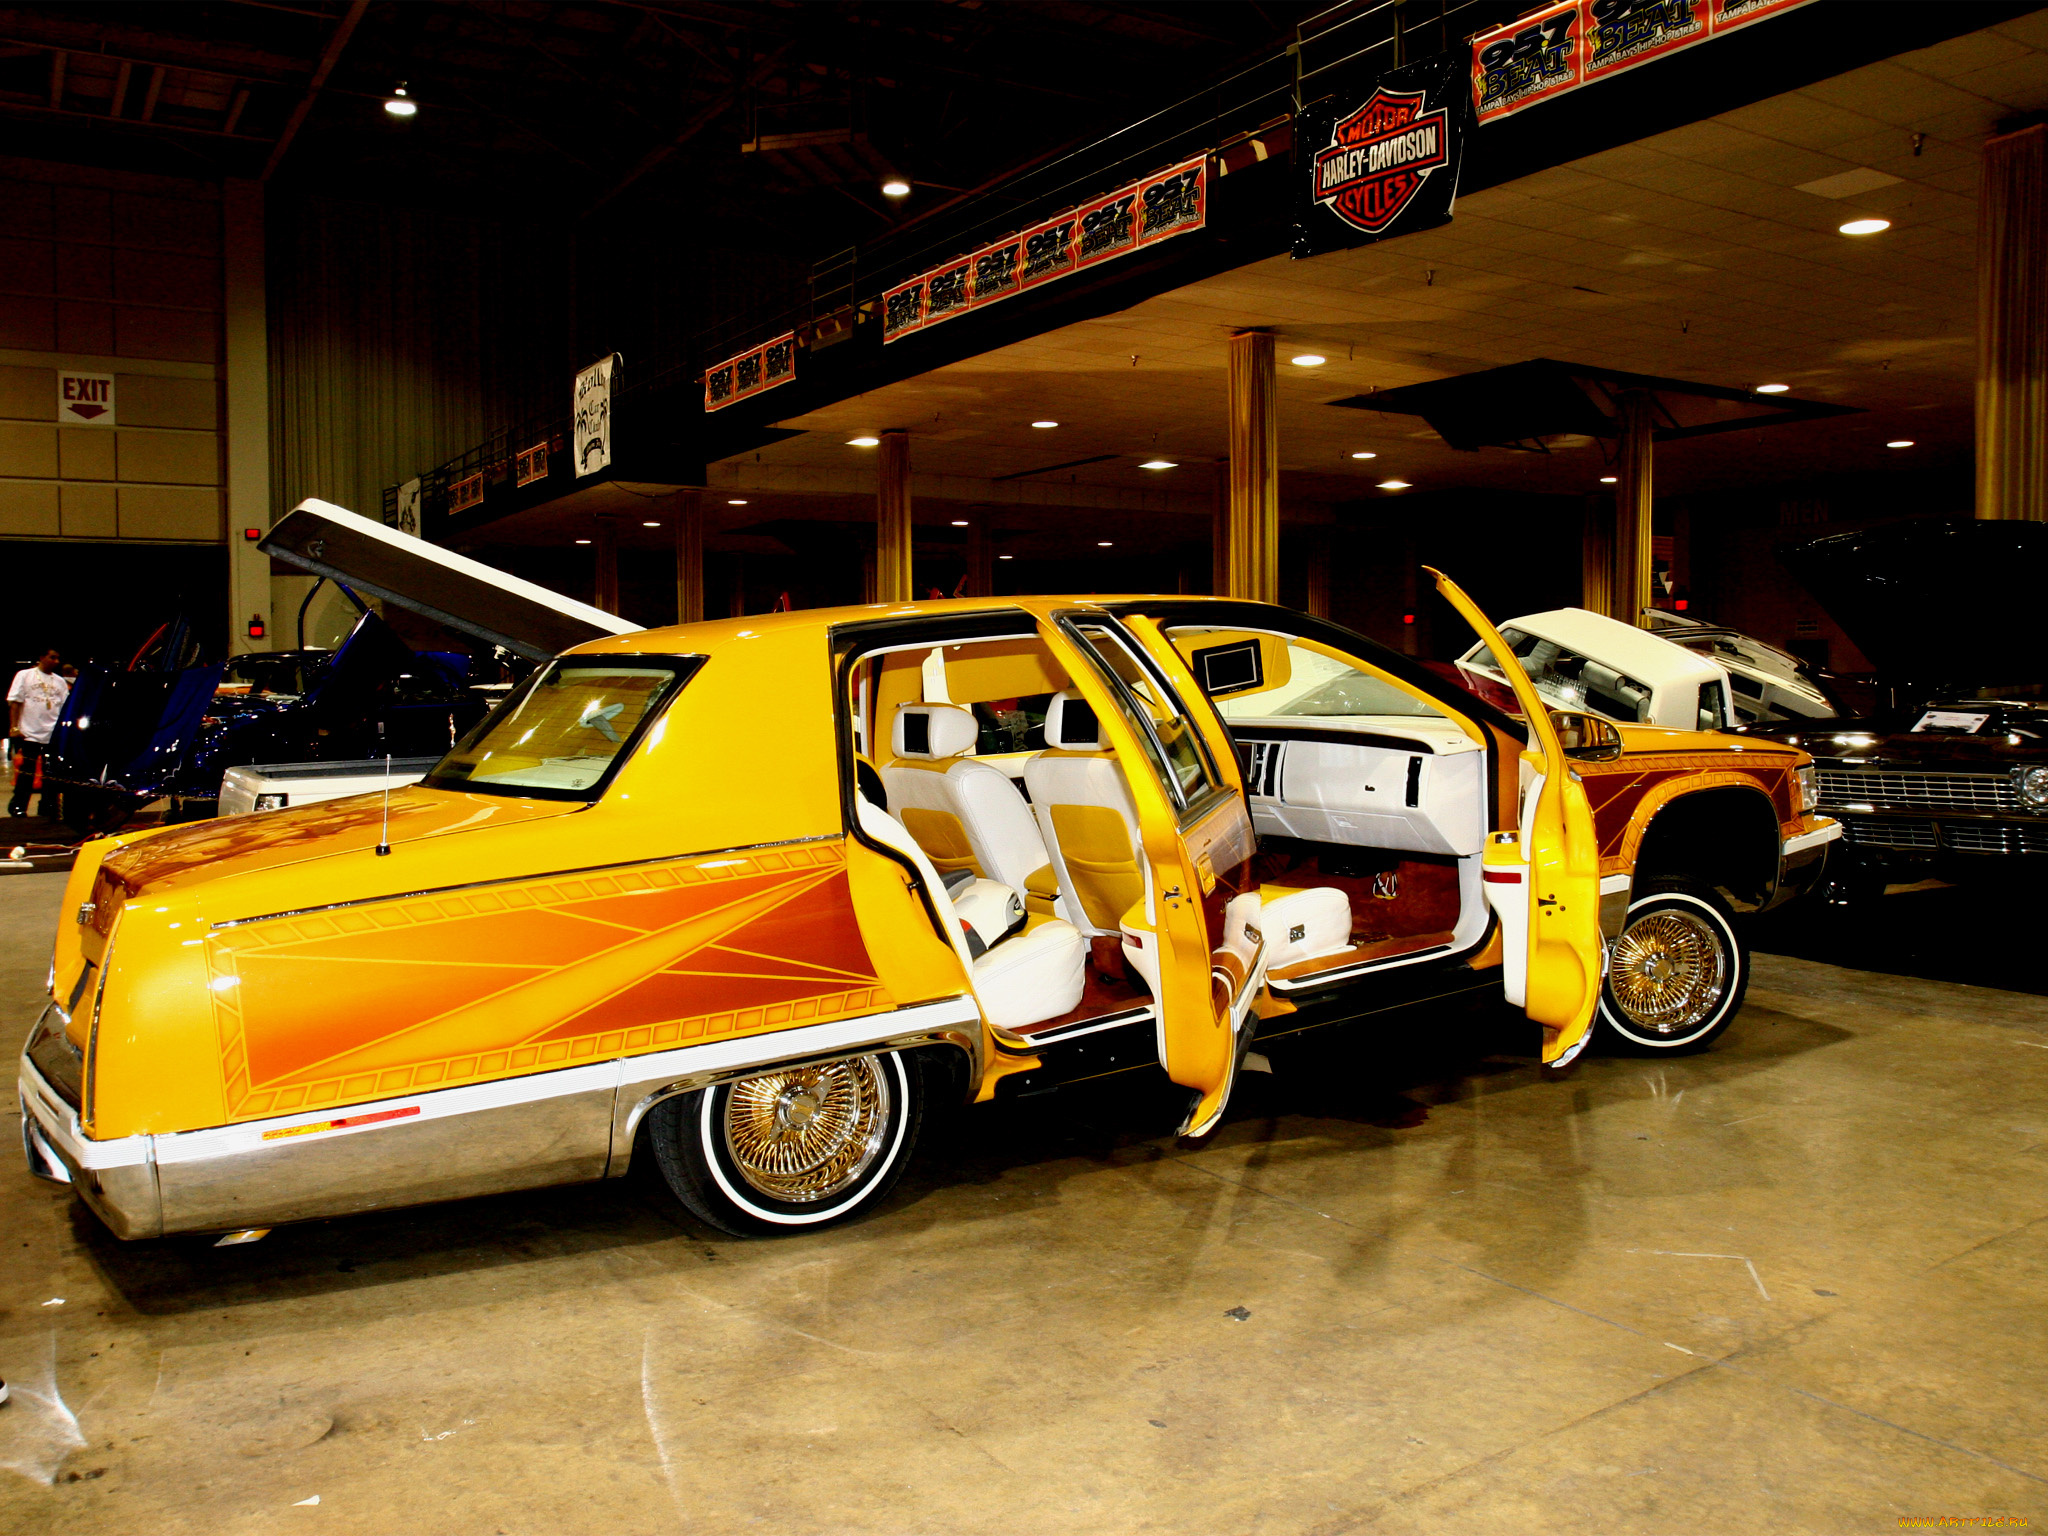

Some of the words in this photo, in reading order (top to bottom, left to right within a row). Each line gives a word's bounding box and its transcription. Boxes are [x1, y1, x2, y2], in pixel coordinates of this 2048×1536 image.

[1718, 2, 1748, 22] TAMPA
[1480, 9, 1577, 70] 95.7
[1587, 53, 1616, 71] TAMPA
[1640, 32, 1671, 50] HIP-HOP
[1483, 37, 1574, 104] BEAT
[1477, 100, 1501, 114] TAMPA
[1521, 81, 1549, 97] HIP-HOP
[1347, 103, 1410, 143] MOTOR
[1322, 126, 1436, 188] HARLEY-DAVIDSON
[1143, 166, 1202, 203] 95.7
[1345, 174, 1407, 218] CYCLES
[1081, 194, 1136, 230] 95.7
[1026, 220, 1075, 254] 95.7
[976, 242, 1020, 274] 95.7
[63, 377, 110, 402] EXIT
[1779, 499, 1829, 524] MEN
